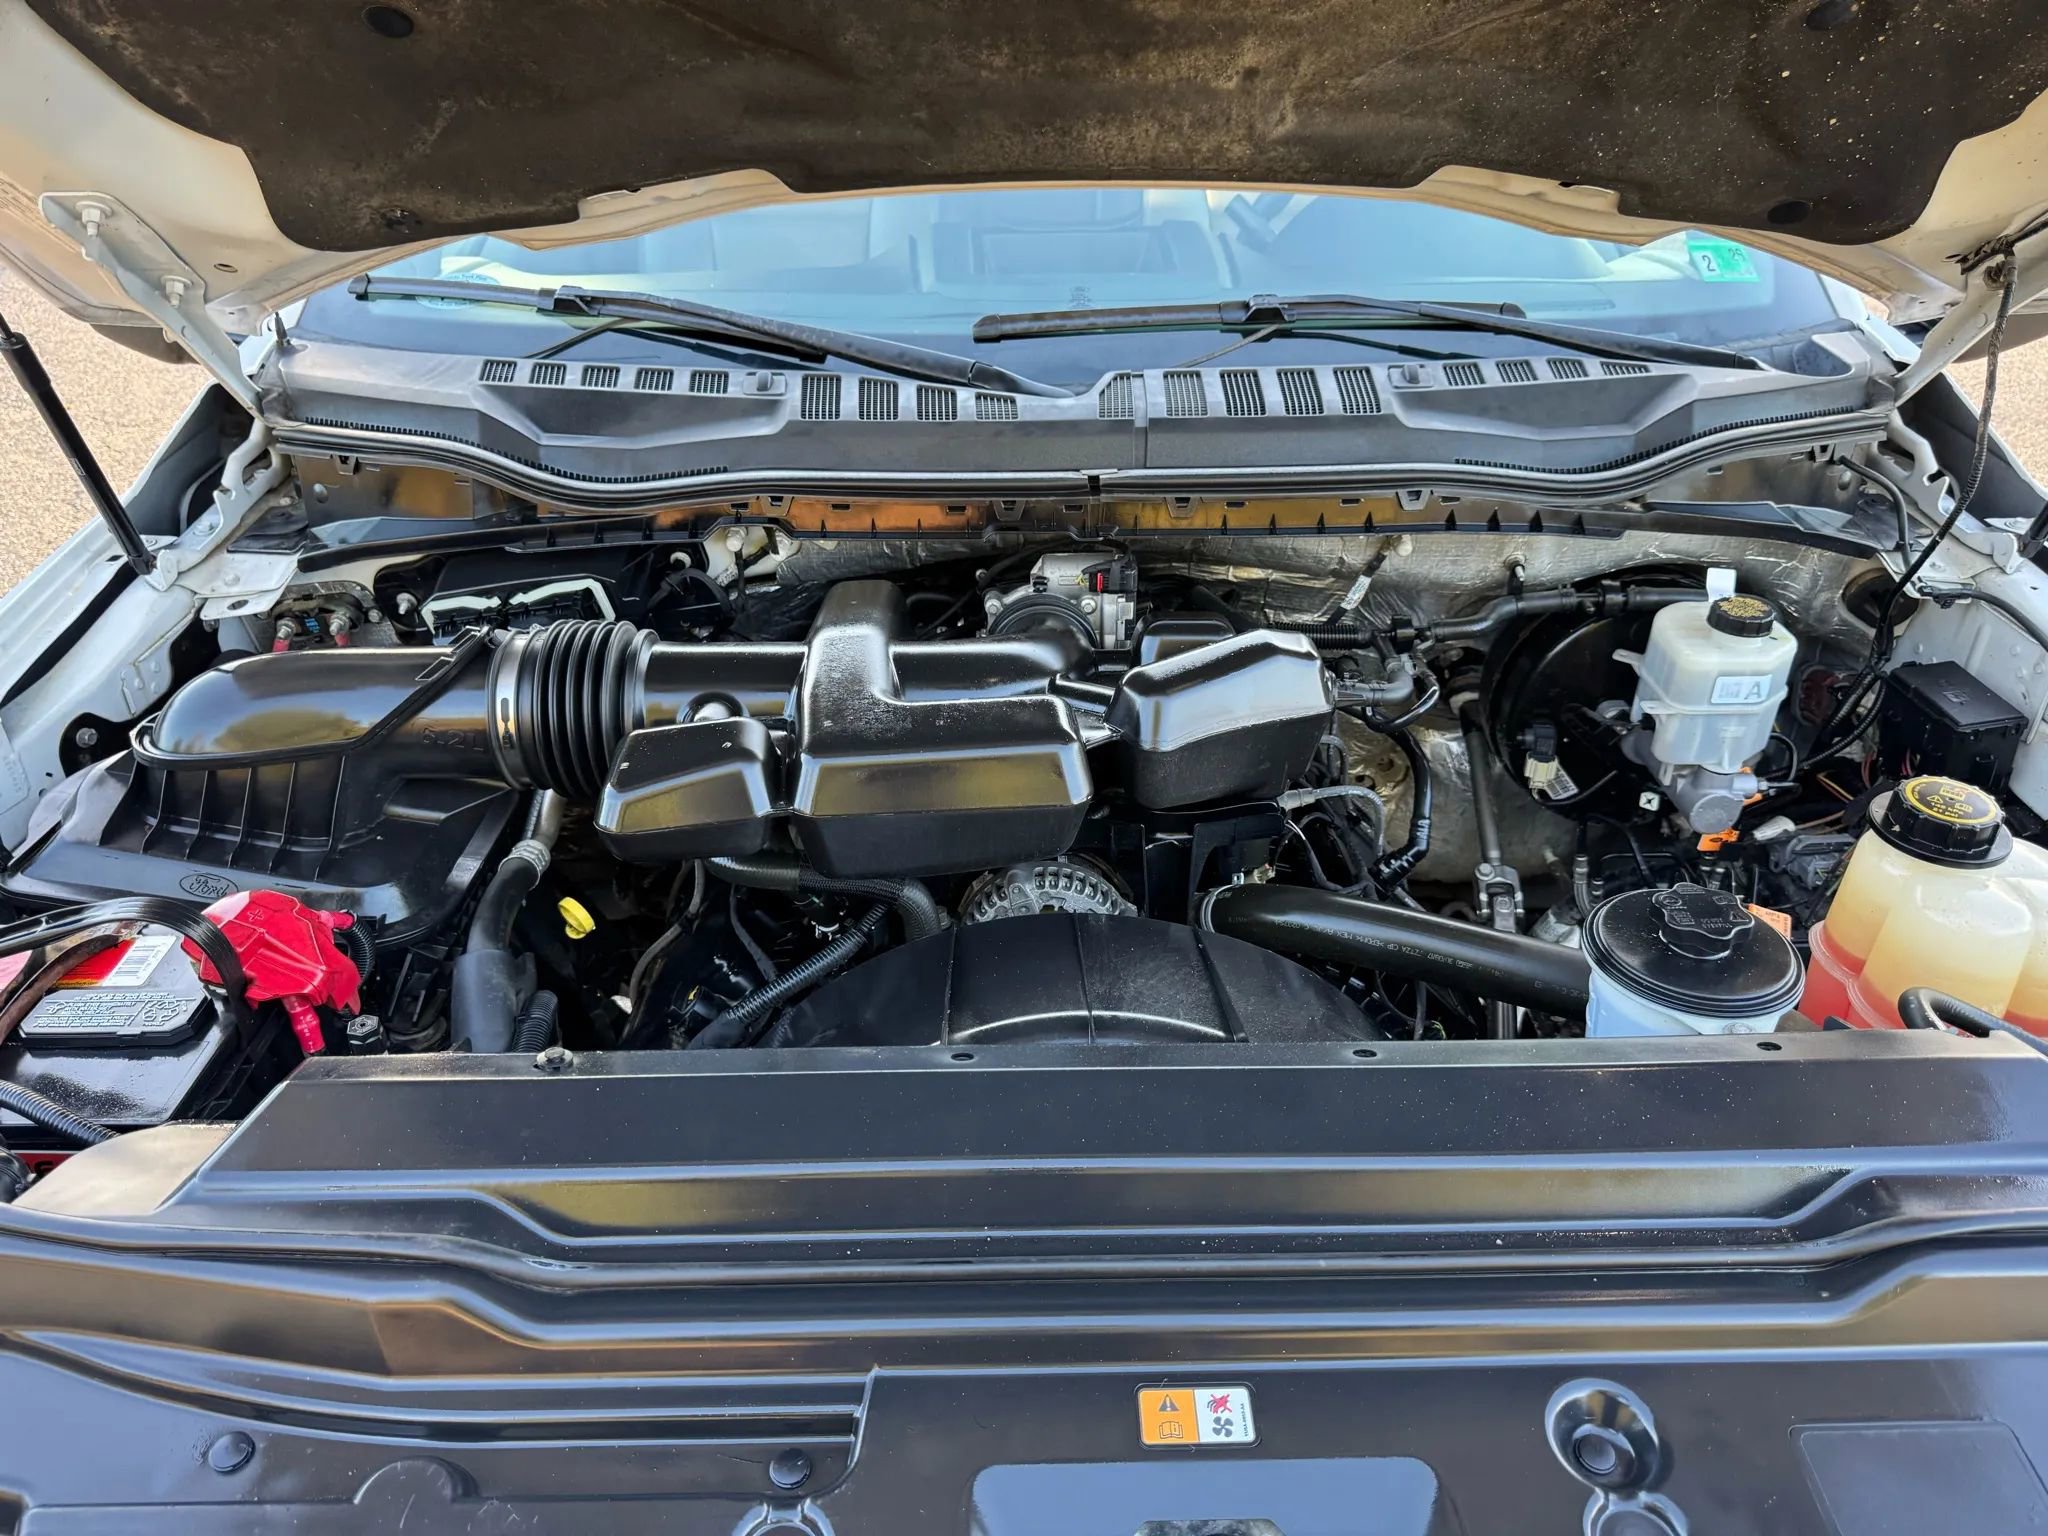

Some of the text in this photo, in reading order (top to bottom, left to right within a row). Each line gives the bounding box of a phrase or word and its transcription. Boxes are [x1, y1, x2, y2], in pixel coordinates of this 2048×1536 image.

[1701, 254, 1716, 272] 2
[1743, 680, 1762, 700] A
[189, 874, 230, 897] Ford
